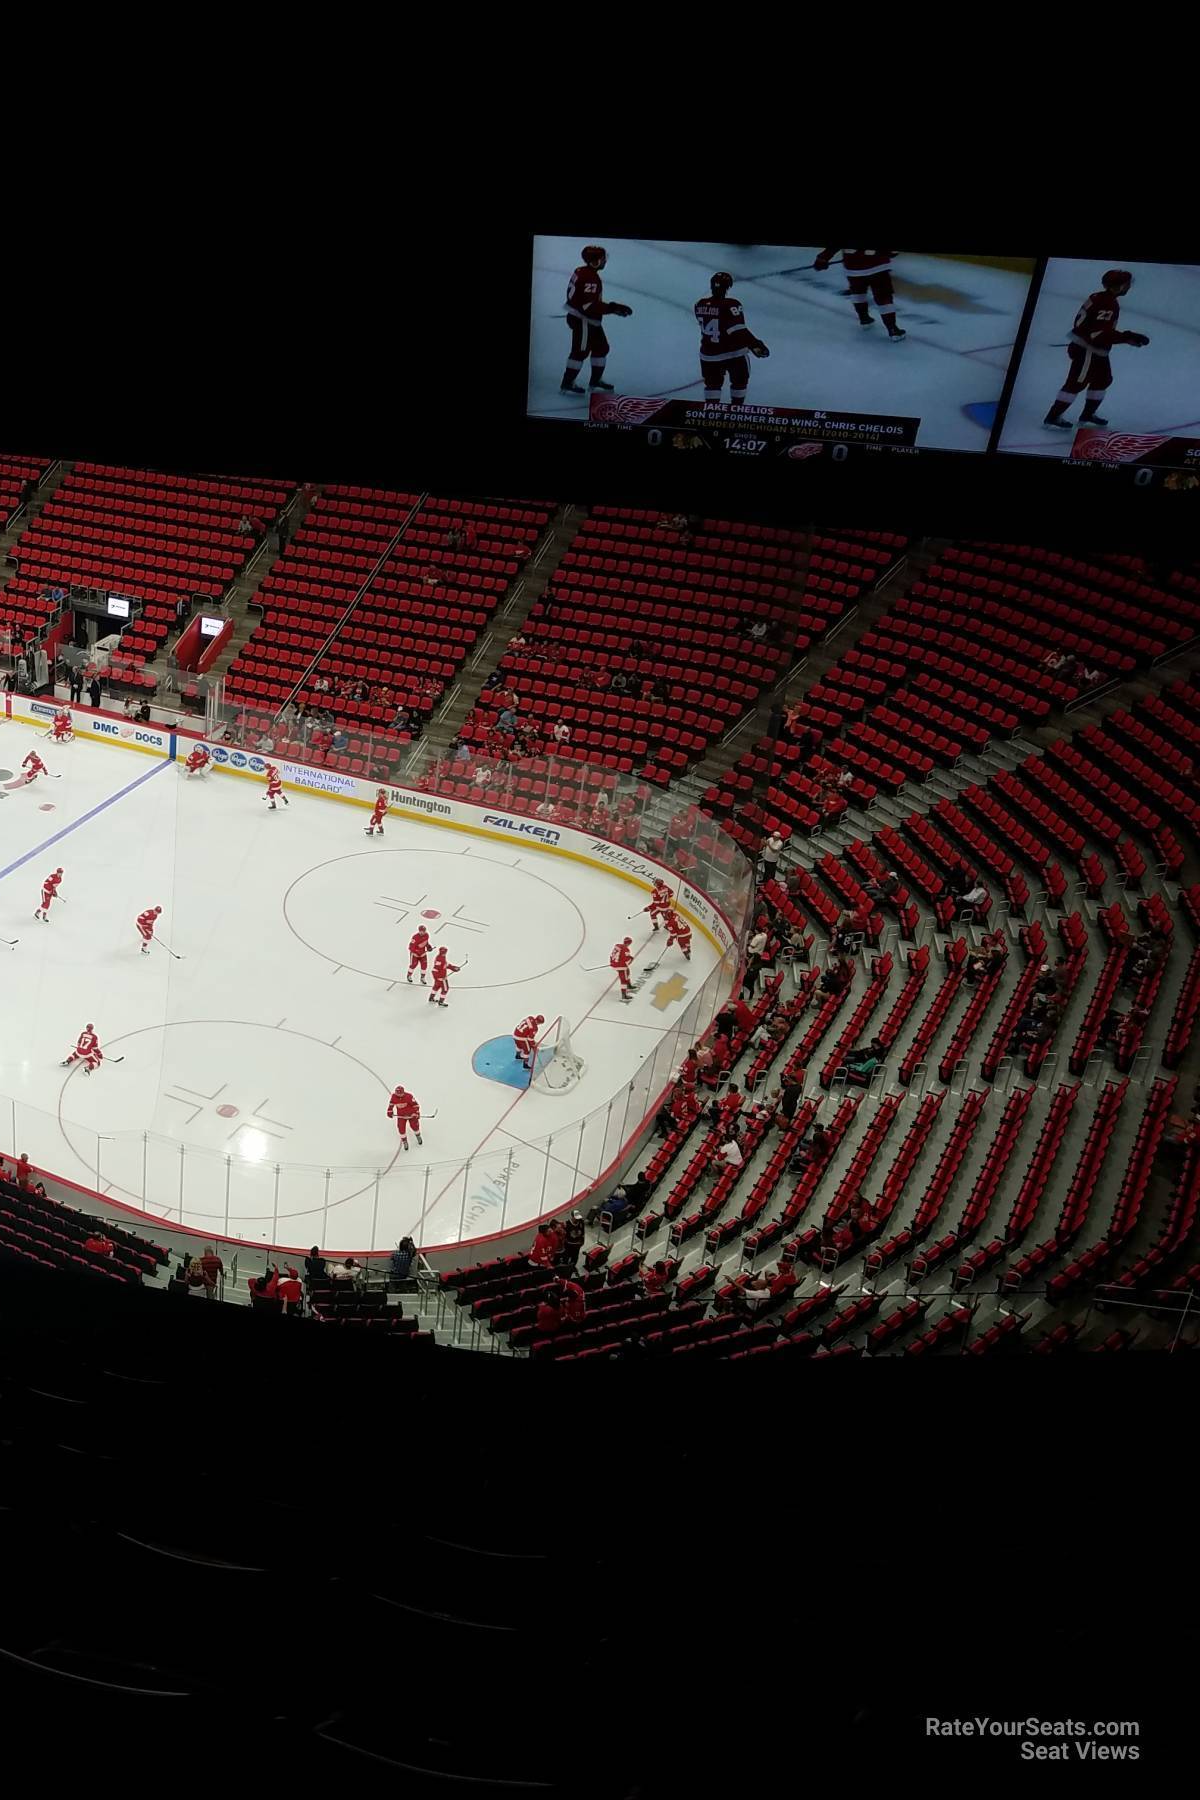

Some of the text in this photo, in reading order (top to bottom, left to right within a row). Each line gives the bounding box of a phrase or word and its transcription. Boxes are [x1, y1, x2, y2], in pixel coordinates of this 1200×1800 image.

[702, 403, 774, 415] JAKE CHELIOS
[814, 411, 826, 419] 84
[685, 410, 903, 435] SON OF FORMER RED WING, CHRIS CHELOIS
[648, 428, 661, 446] 0
[723, 438, 768, 451] 14:07
[832, 444, 849, 462] 0
[93, 721, 119, 735] DMC
[135, 732, 163, 746] DOCS
[282, 764, 356, 788] INTERNATIONAL
[294, 776, 341, 794] BANCARD
[391, 790, 452, 815] Huntington
[540, 837, 558, 846] TIRES
